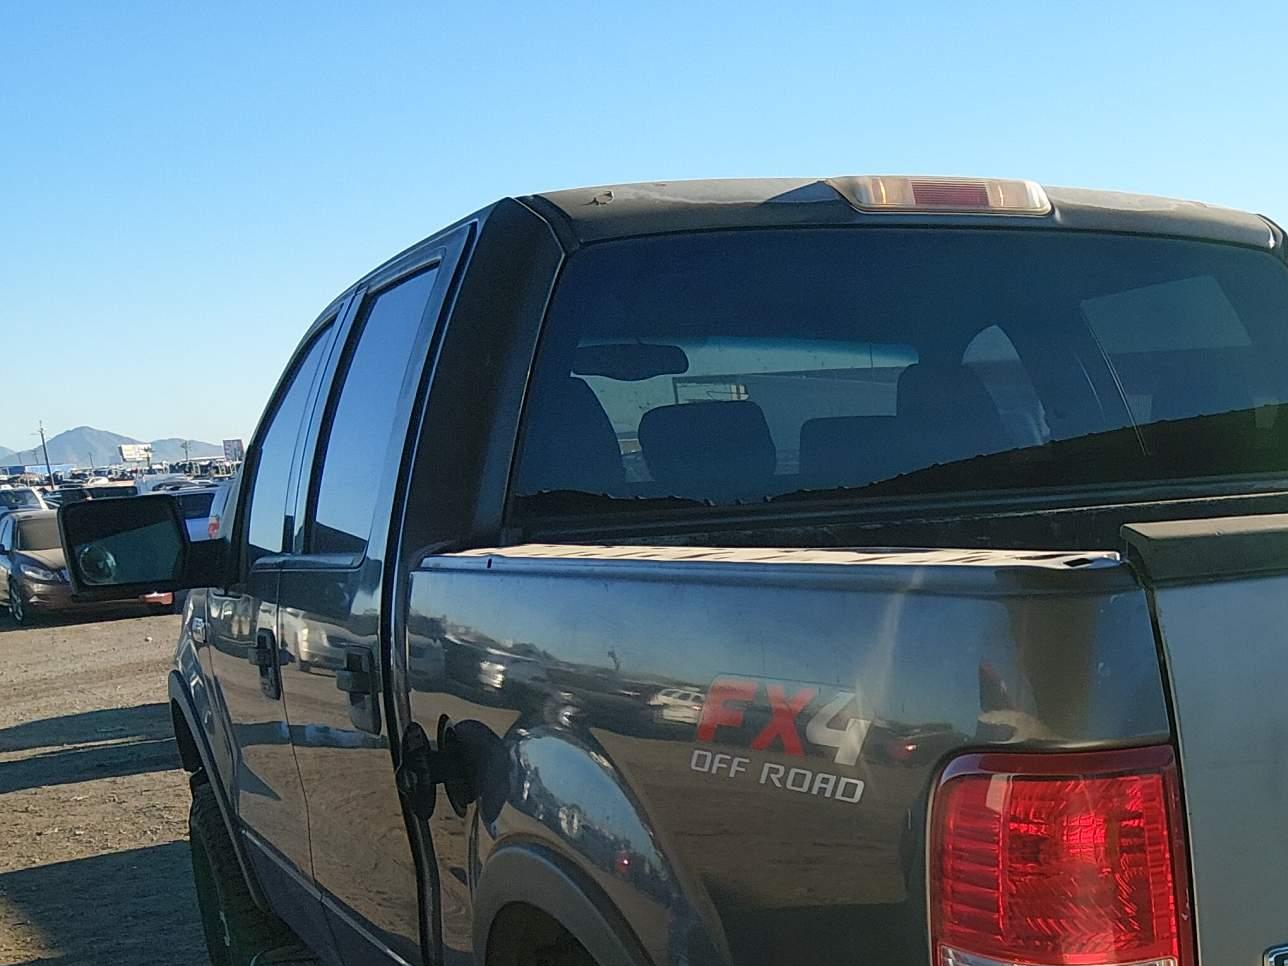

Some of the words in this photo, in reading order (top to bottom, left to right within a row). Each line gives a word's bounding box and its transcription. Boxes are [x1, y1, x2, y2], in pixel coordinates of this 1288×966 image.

[695, 677, 873, 767] FX4
[690, 750, 751, 778] OFF
[759, 762, 866, 804] ROAD
